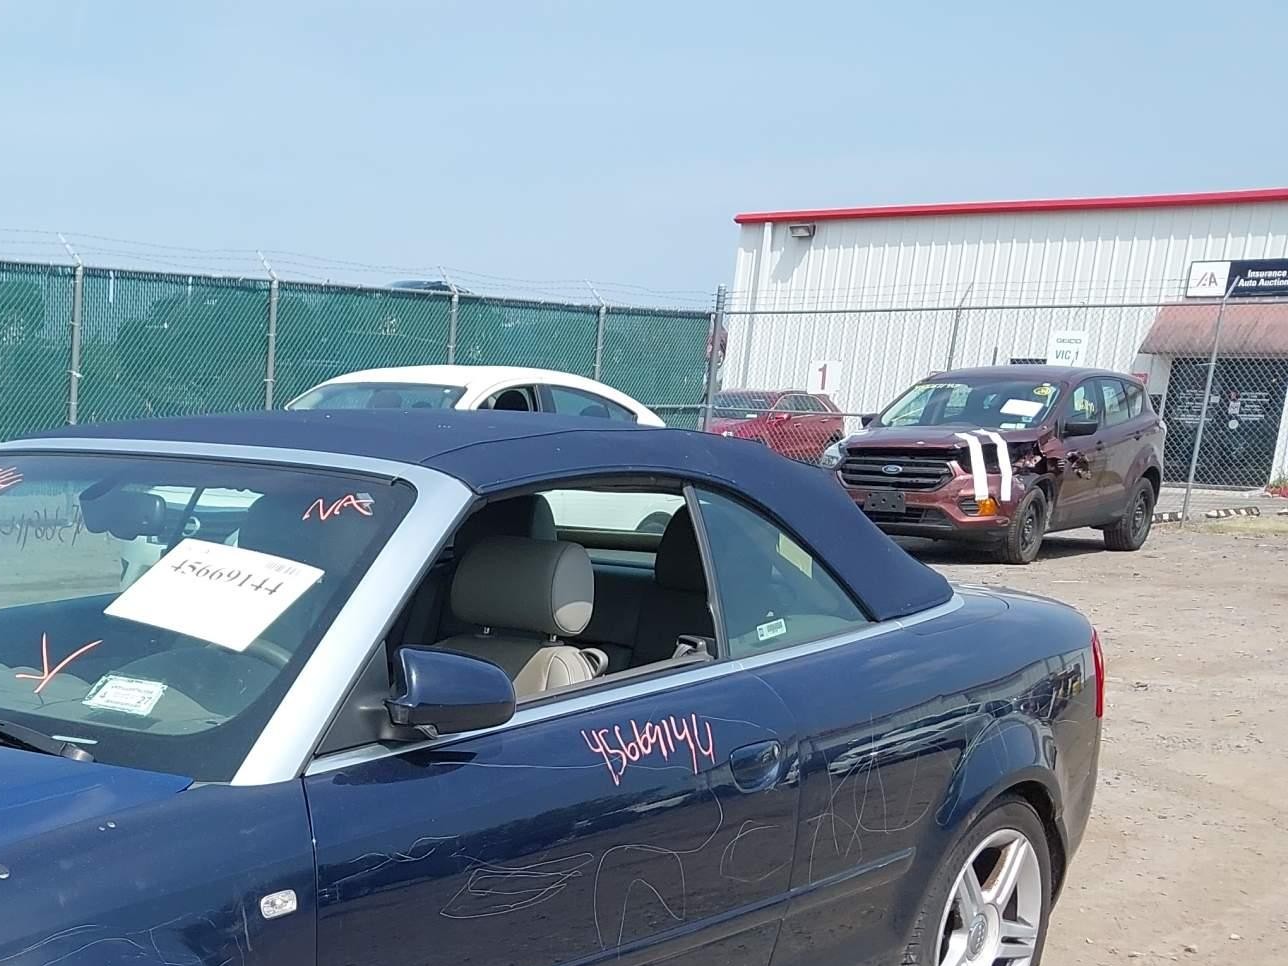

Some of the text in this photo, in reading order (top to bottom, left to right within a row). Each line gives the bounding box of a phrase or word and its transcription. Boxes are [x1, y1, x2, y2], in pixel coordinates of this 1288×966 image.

[1237, 279, 1258, 288] Auto
[1247, 269, 1288, 278] Insurance
[817, 363, 827, 391] 1
[171, 559, 285, 596] 45669144
[580, 713, 716, 787] 45669144
